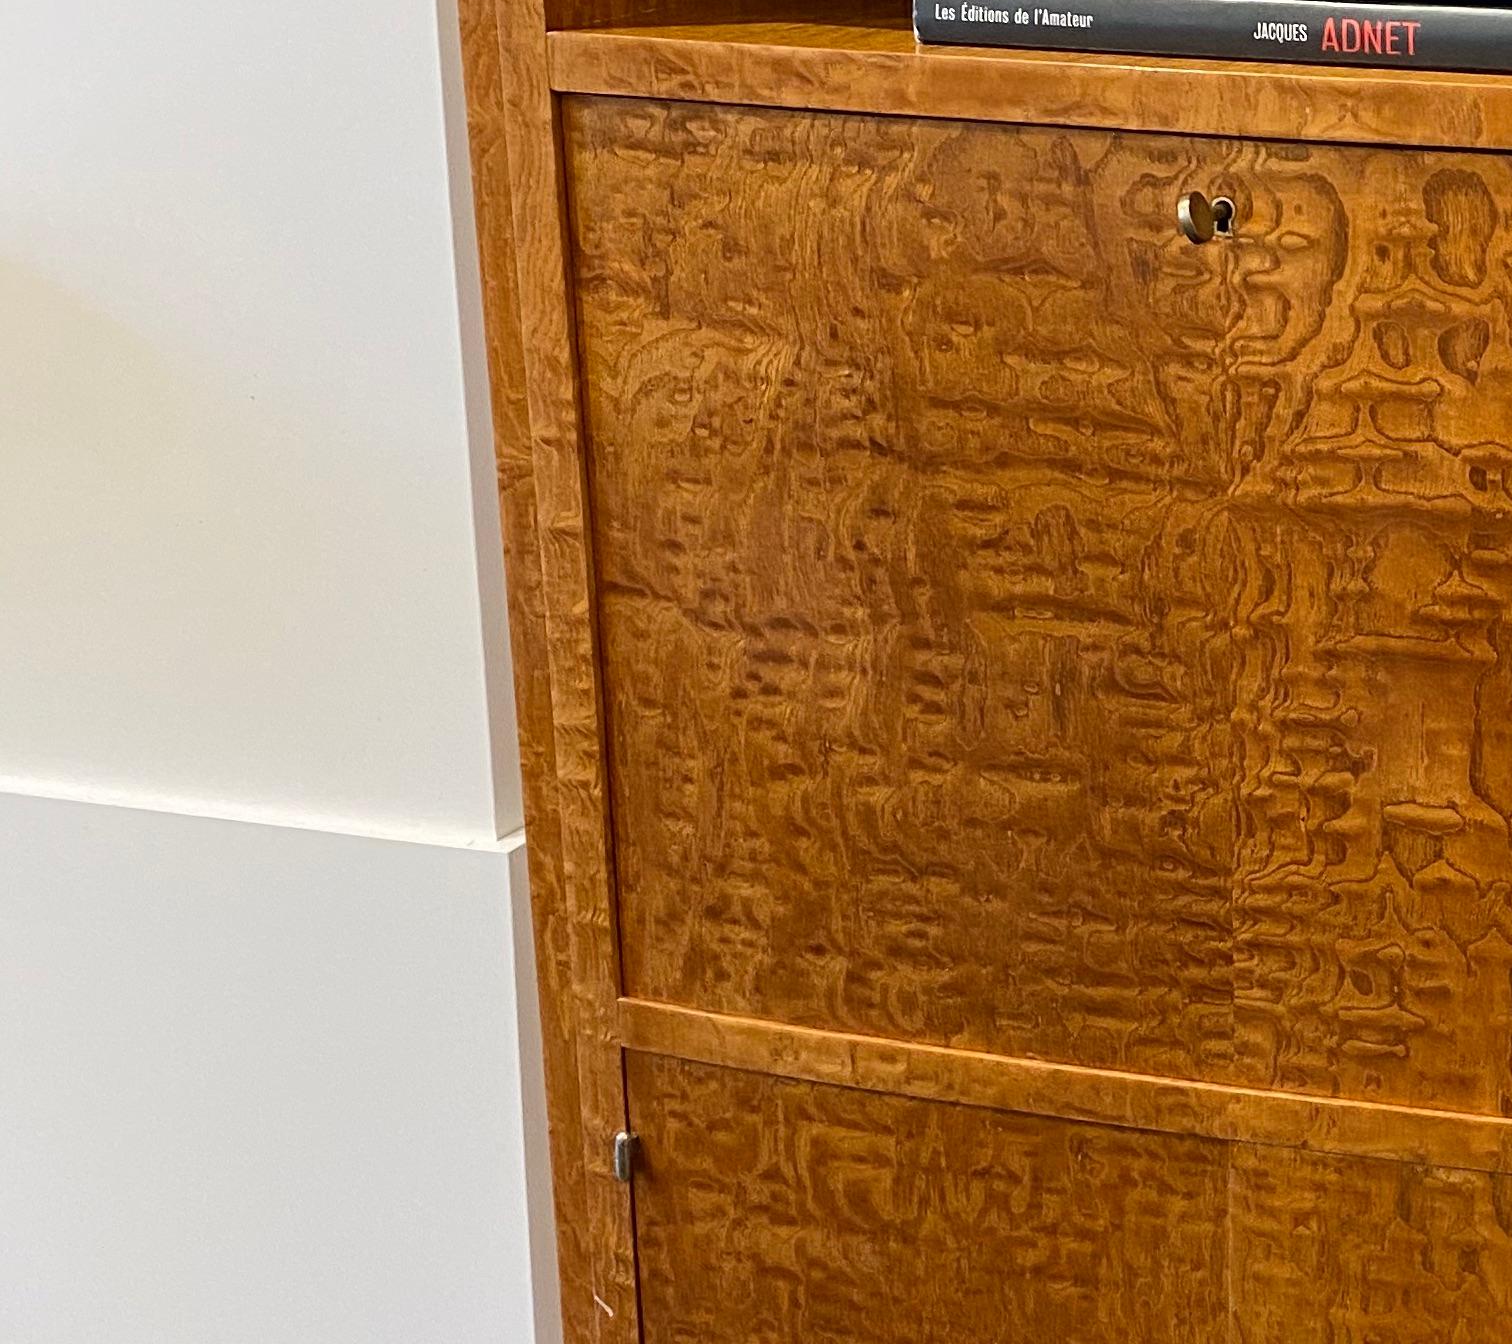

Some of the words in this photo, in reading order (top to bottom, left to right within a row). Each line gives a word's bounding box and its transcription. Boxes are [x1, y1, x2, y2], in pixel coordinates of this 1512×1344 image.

[935, 3, 956, 21] Les
[961, 1, 1010, 24] Éditions
[1014, 8, 1029, 25] de
[1034, 8, 1094, 29] l'Amateur
[1253, 21, 1308, 44] JACQUES
[1321, 16, 1422, 56] ADNET
